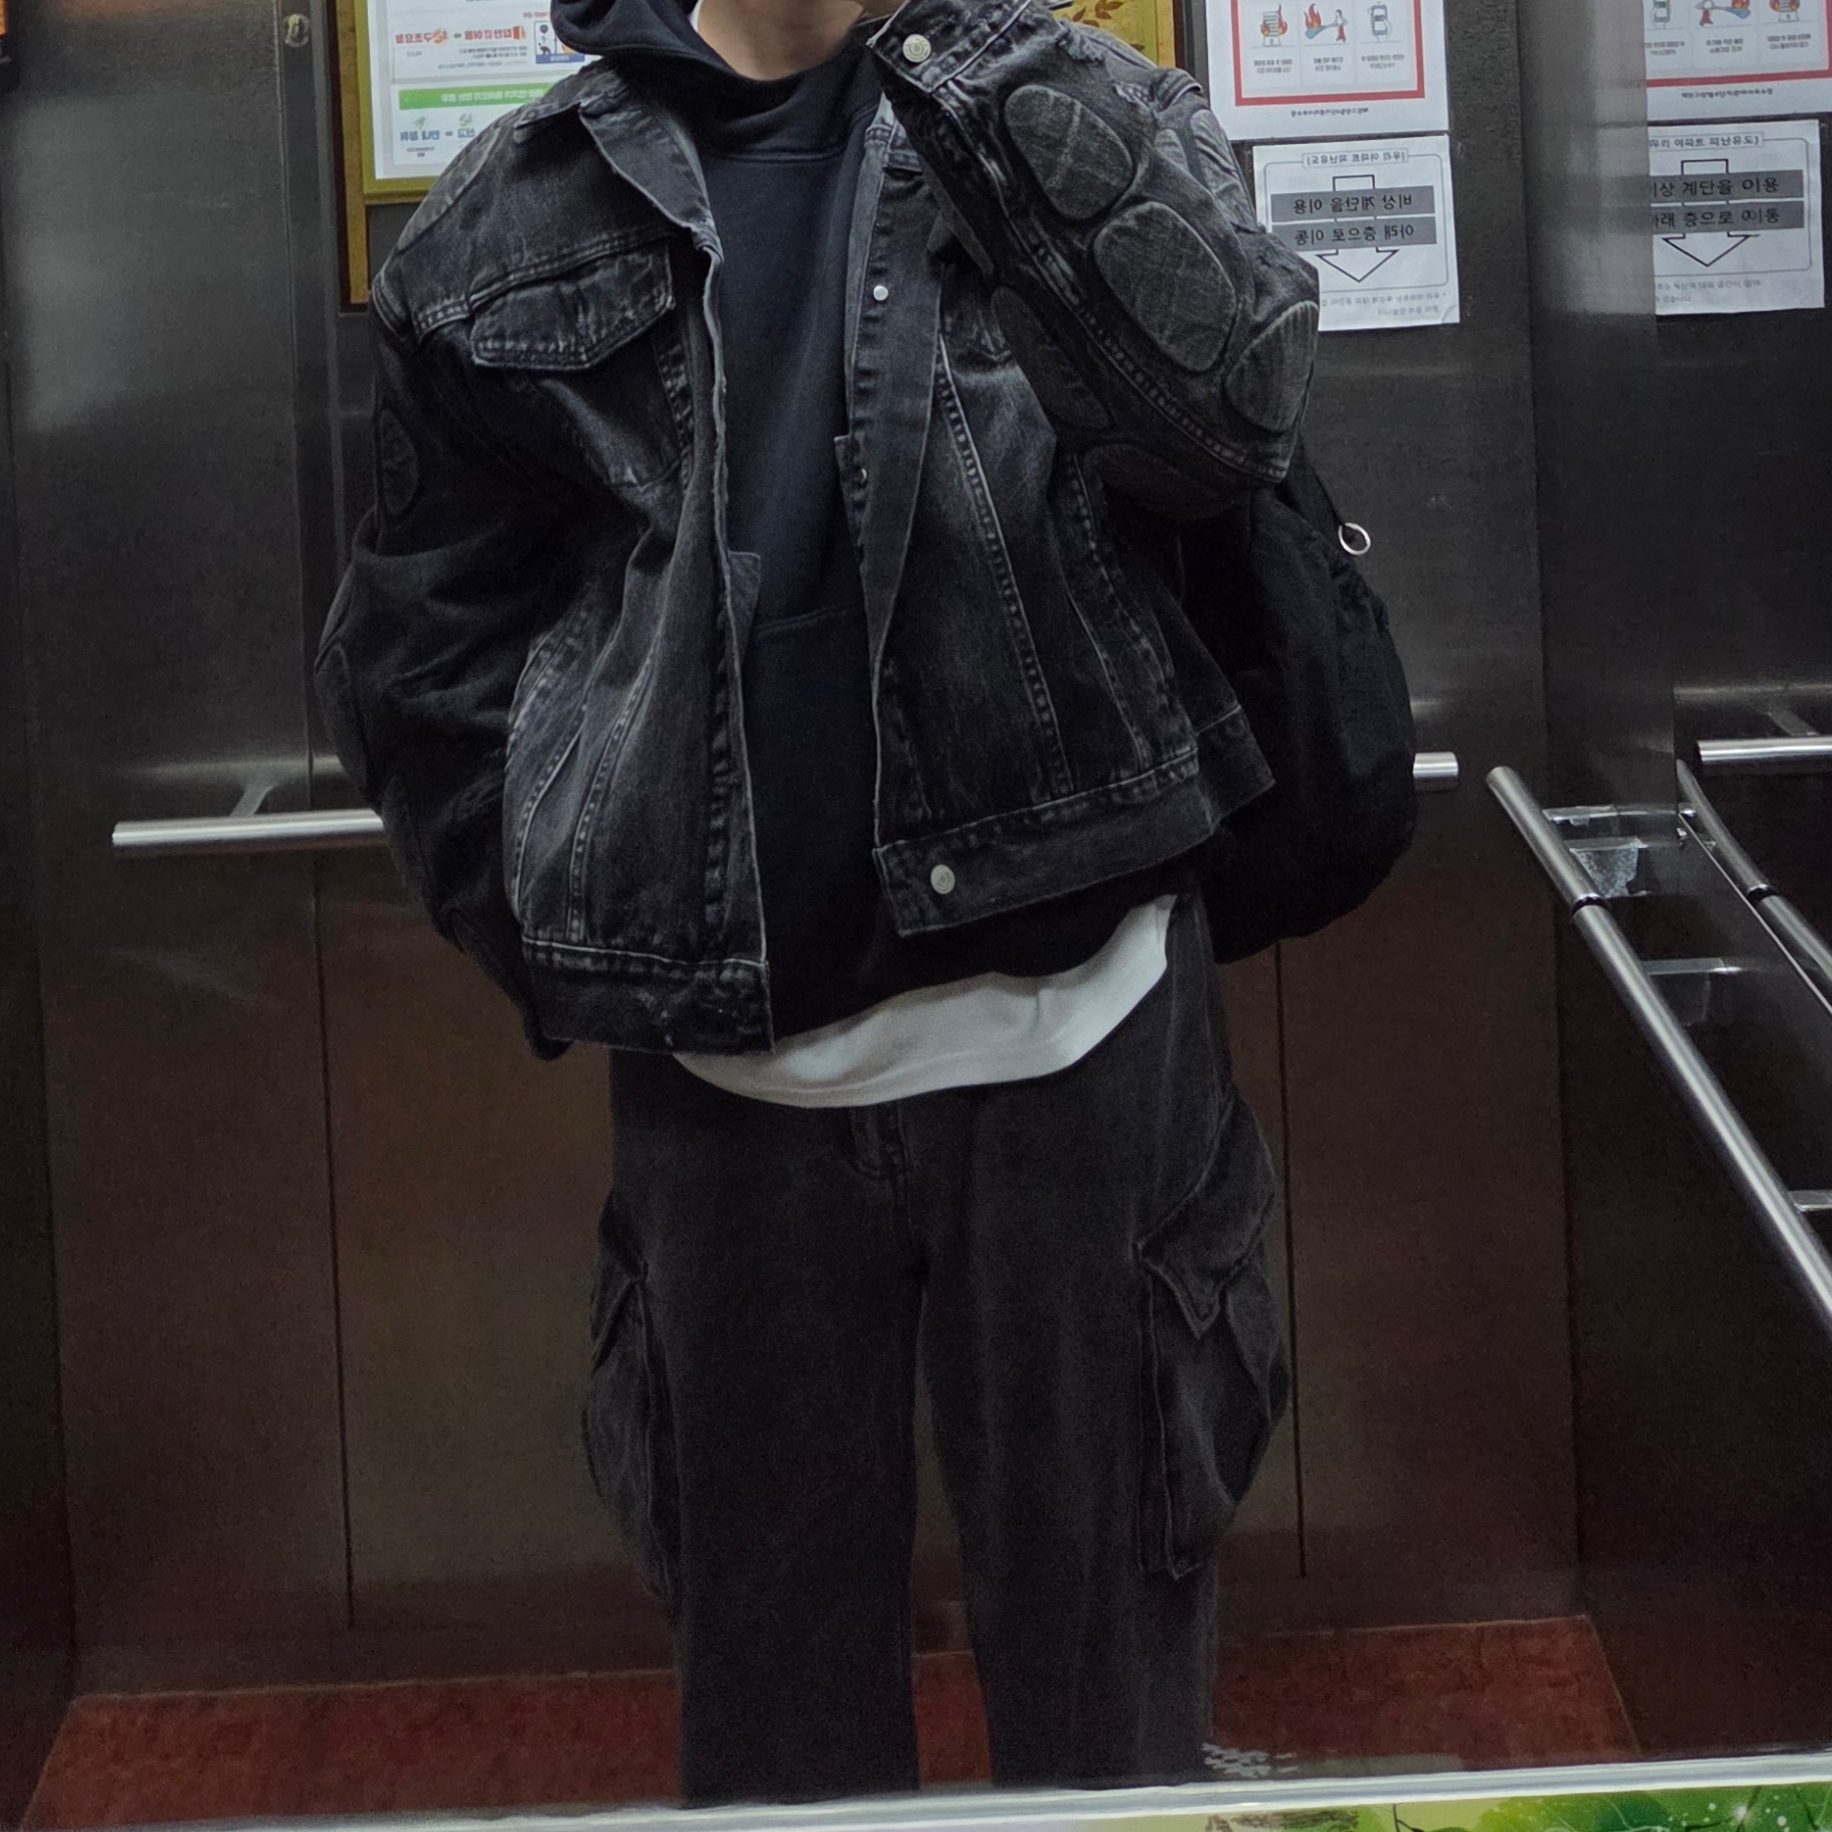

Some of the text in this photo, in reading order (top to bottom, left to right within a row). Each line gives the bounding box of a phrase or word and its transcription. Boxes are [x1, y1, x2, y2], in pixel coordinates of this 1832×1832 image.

[1682, 178, 1734, 197] 계단을
[1742, 176, 1779, 194] 이용
[1683, 210, 1735, 228] 층으로
[1741, 207, 1780, 224] 이동
